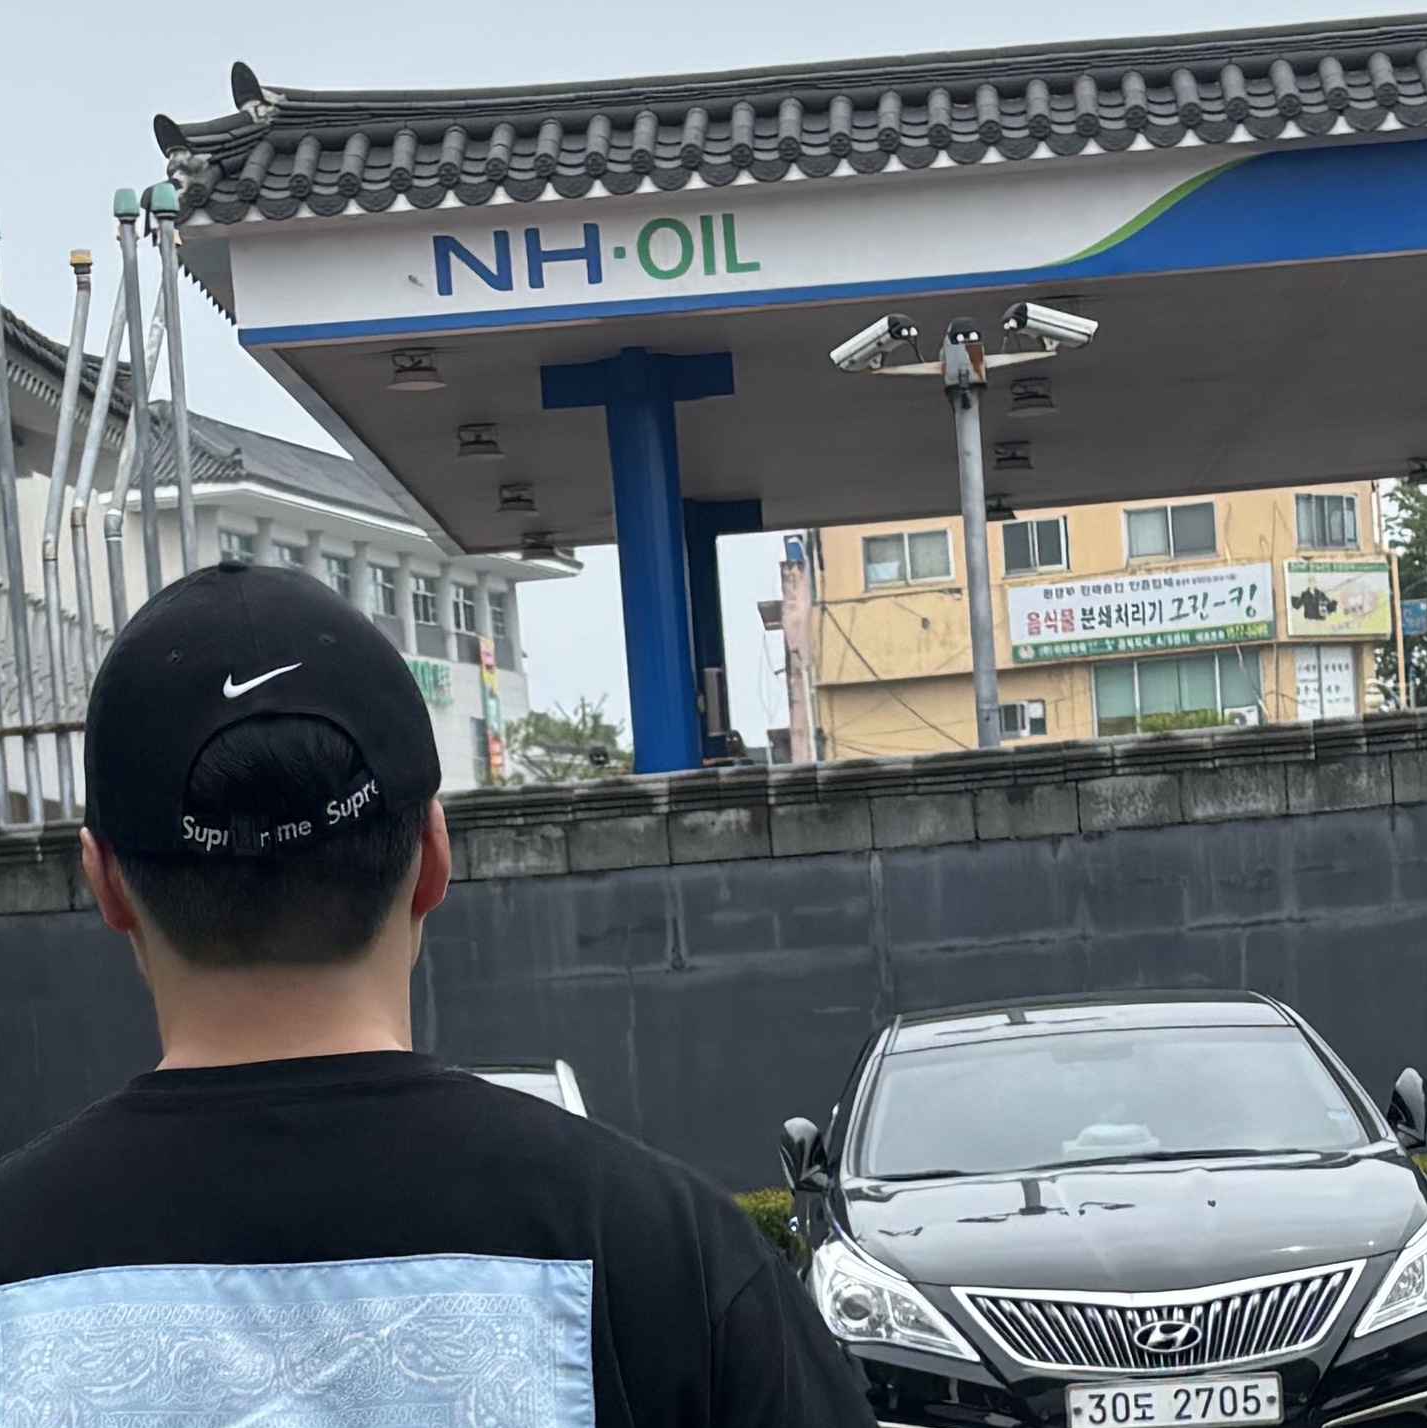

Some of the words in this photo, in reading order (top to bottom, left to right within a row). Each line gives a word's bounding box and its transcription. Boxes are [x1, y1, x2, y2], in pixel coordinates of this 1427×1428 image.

[1081, 599, 1163, 631] 분쇄처리기
[1088, 1392, 1154, 1425] 30도
[1173, 1384, 1261, 1420] 2705
